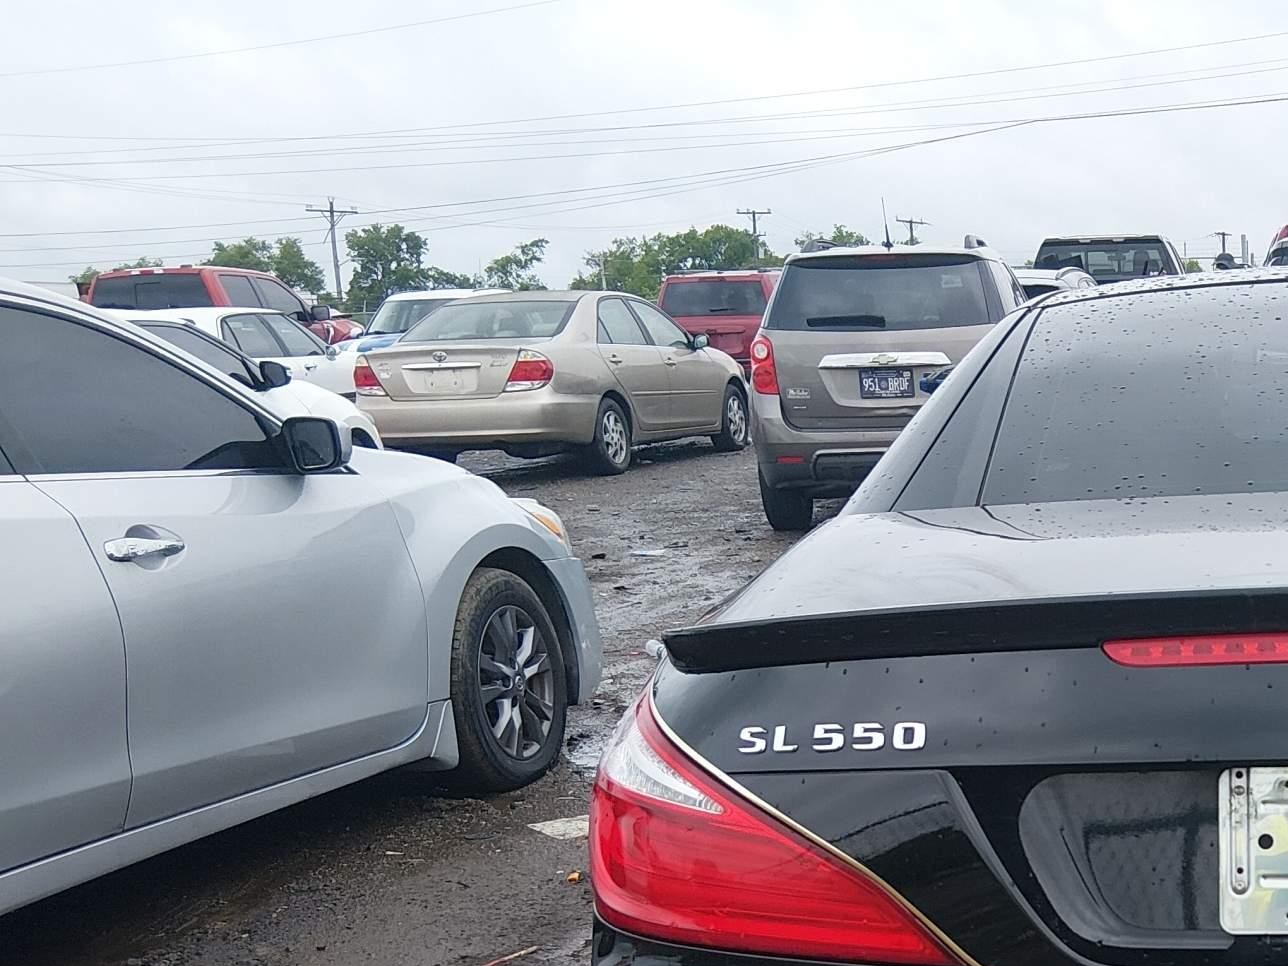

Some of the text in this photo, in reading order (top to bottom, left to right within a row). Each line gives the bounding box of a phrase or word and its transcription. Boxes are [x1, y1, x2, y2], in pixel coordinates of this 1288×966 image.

[863, 377, 910, 391] 951 BRDF
[737, 722, 927, 753] SL 550
